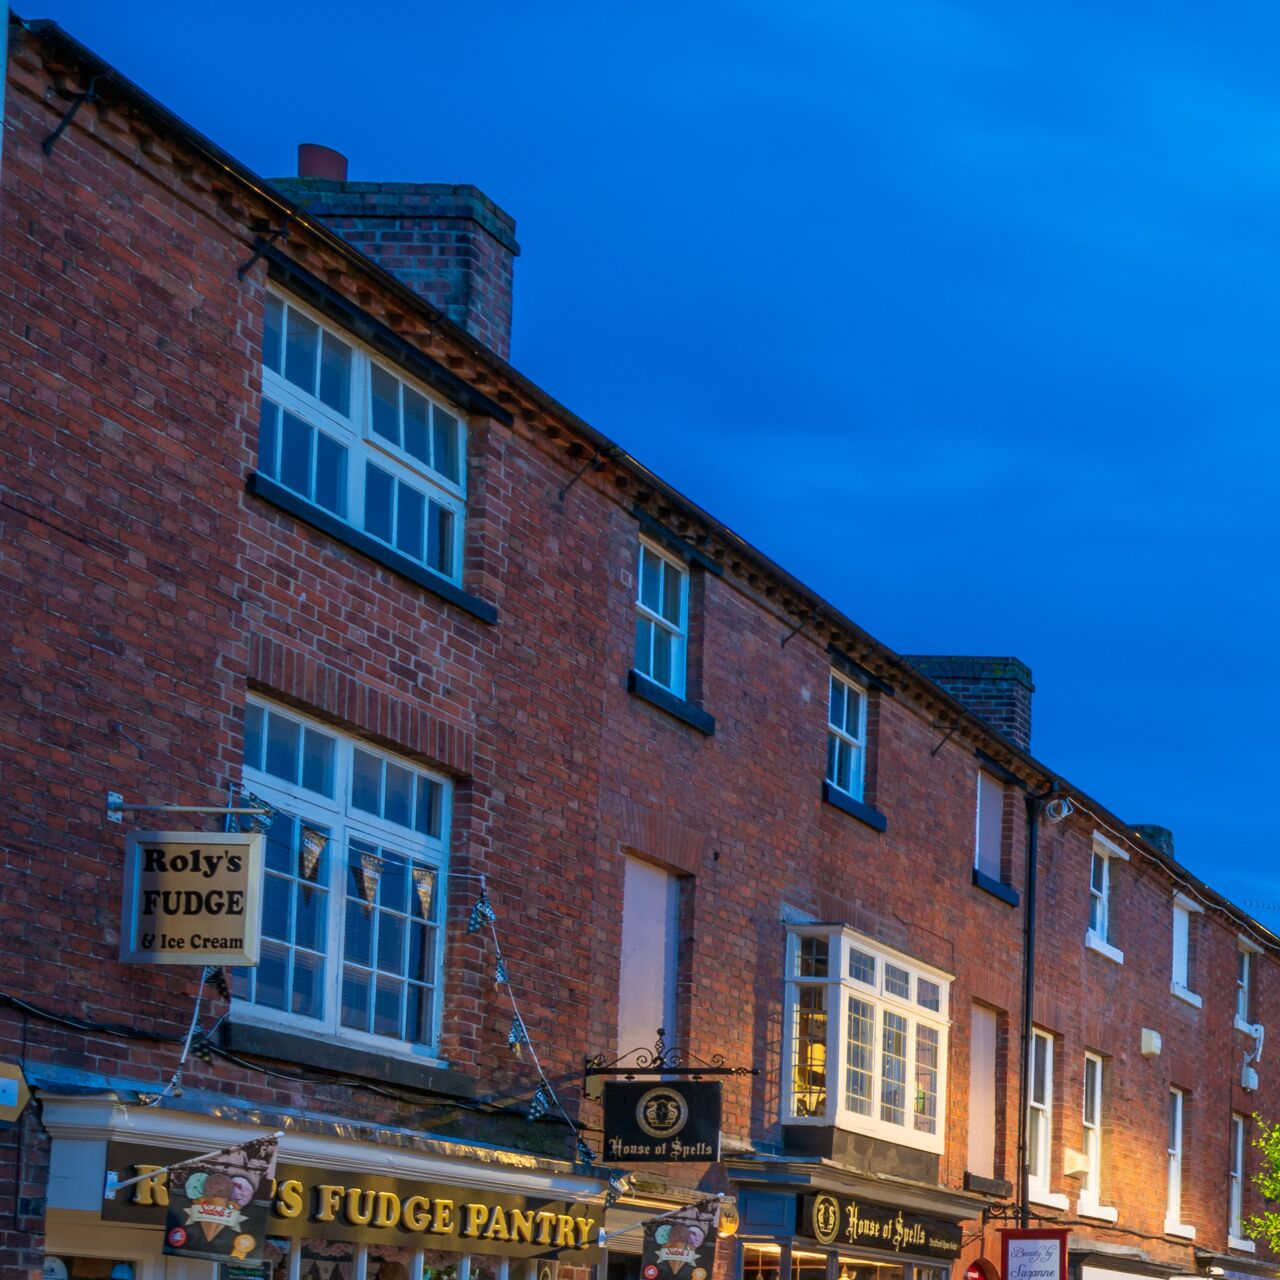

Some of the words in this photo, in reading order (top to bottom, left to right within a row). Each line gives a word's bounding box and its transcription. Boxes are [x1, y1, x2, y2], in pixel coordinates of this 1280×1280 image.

[143, 849, 242, 878] Roly's
[142, 890, 244, 916] FUDGE
[141, 933, 155, 949] &
[160, 934, 185, 949] Ice
[190, 934, 243, 949] Cream
[608, 1136, 650, 1158] House
[654, 1143, 667, 1155] of
[670, 1136, 713, 1160] Spells
[315, 1184, 454, 1234] FUDGE
[464, 1203, 595, 1249] PANTRY
[845, 1201, 880, 1243] House
[882, 1218, 893, 1239] of
[892, 1210, 926, 1252] Spells
[1010, 1246, 1042, 1263] Beauty
[1041, 1245, 1057, 1262] by
